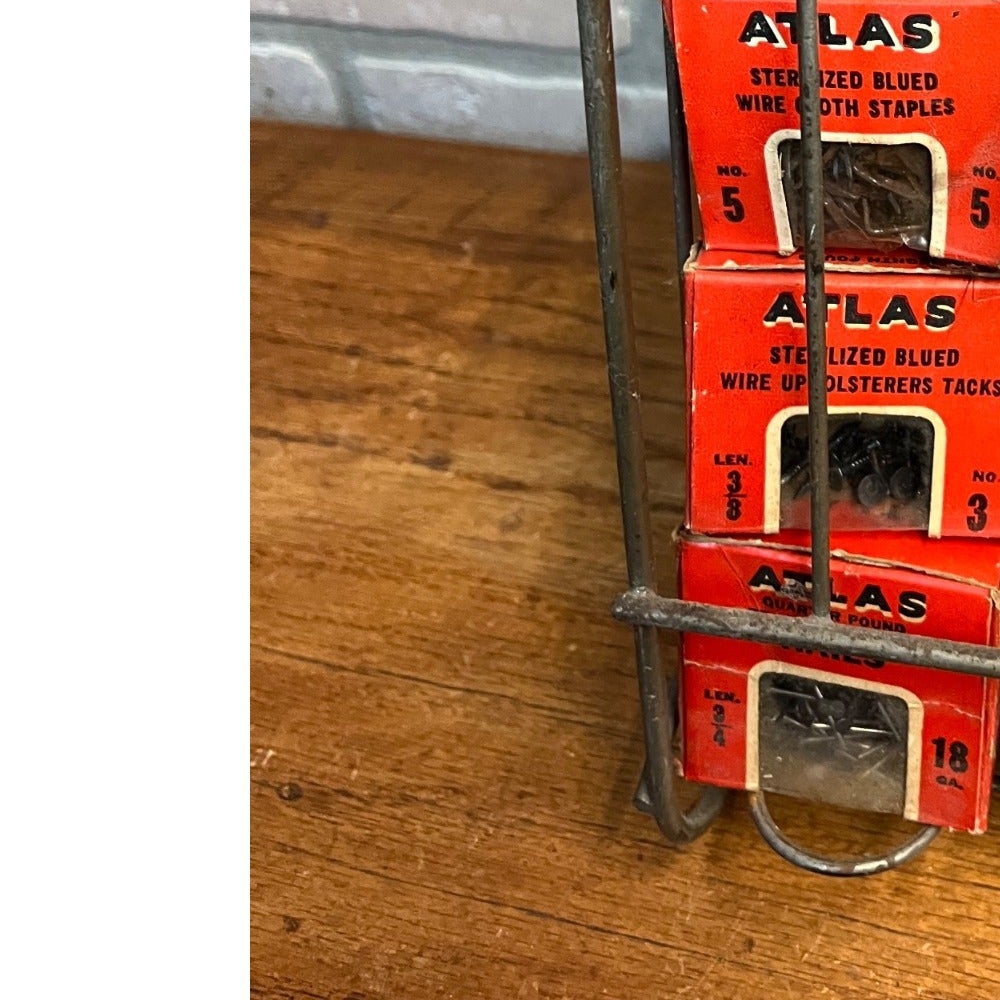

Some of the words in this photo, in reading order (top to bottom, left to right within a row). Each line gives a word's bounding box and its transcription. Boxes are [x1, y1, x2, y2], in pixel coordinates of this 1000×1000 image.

[750, 67, 863, 90] STERIZED
[873, 71, 939, 91] BLUED
[735, 93, 787, 115] WIRE
[794, 96, 859, 118] OTH
[868, 97, 955, 119] STAPLES
[716, 165, 747, 178] NO.
[972, 165, 1000, 181] NO.
[722, 186, 746, 223] 5
[969, 187, 991, 230] 5
[769, 345, 886, 368] STELIZED
[895, 347, 960, 367] BLUED
[720, 371, 772, 391] WIRE
[781, 373, 933, 395] UPOLSTERERS
[713, 453, 752, 466] LEN.
[726, 469, 742, 494] 3
[972, 470, 1000, 484] NO.
[966, 493, 989, 533] 3
[762, 595, 841, 623] QUARR
[848, 613, 907, 634] POUND
[931, 736, 970, 774] 18
